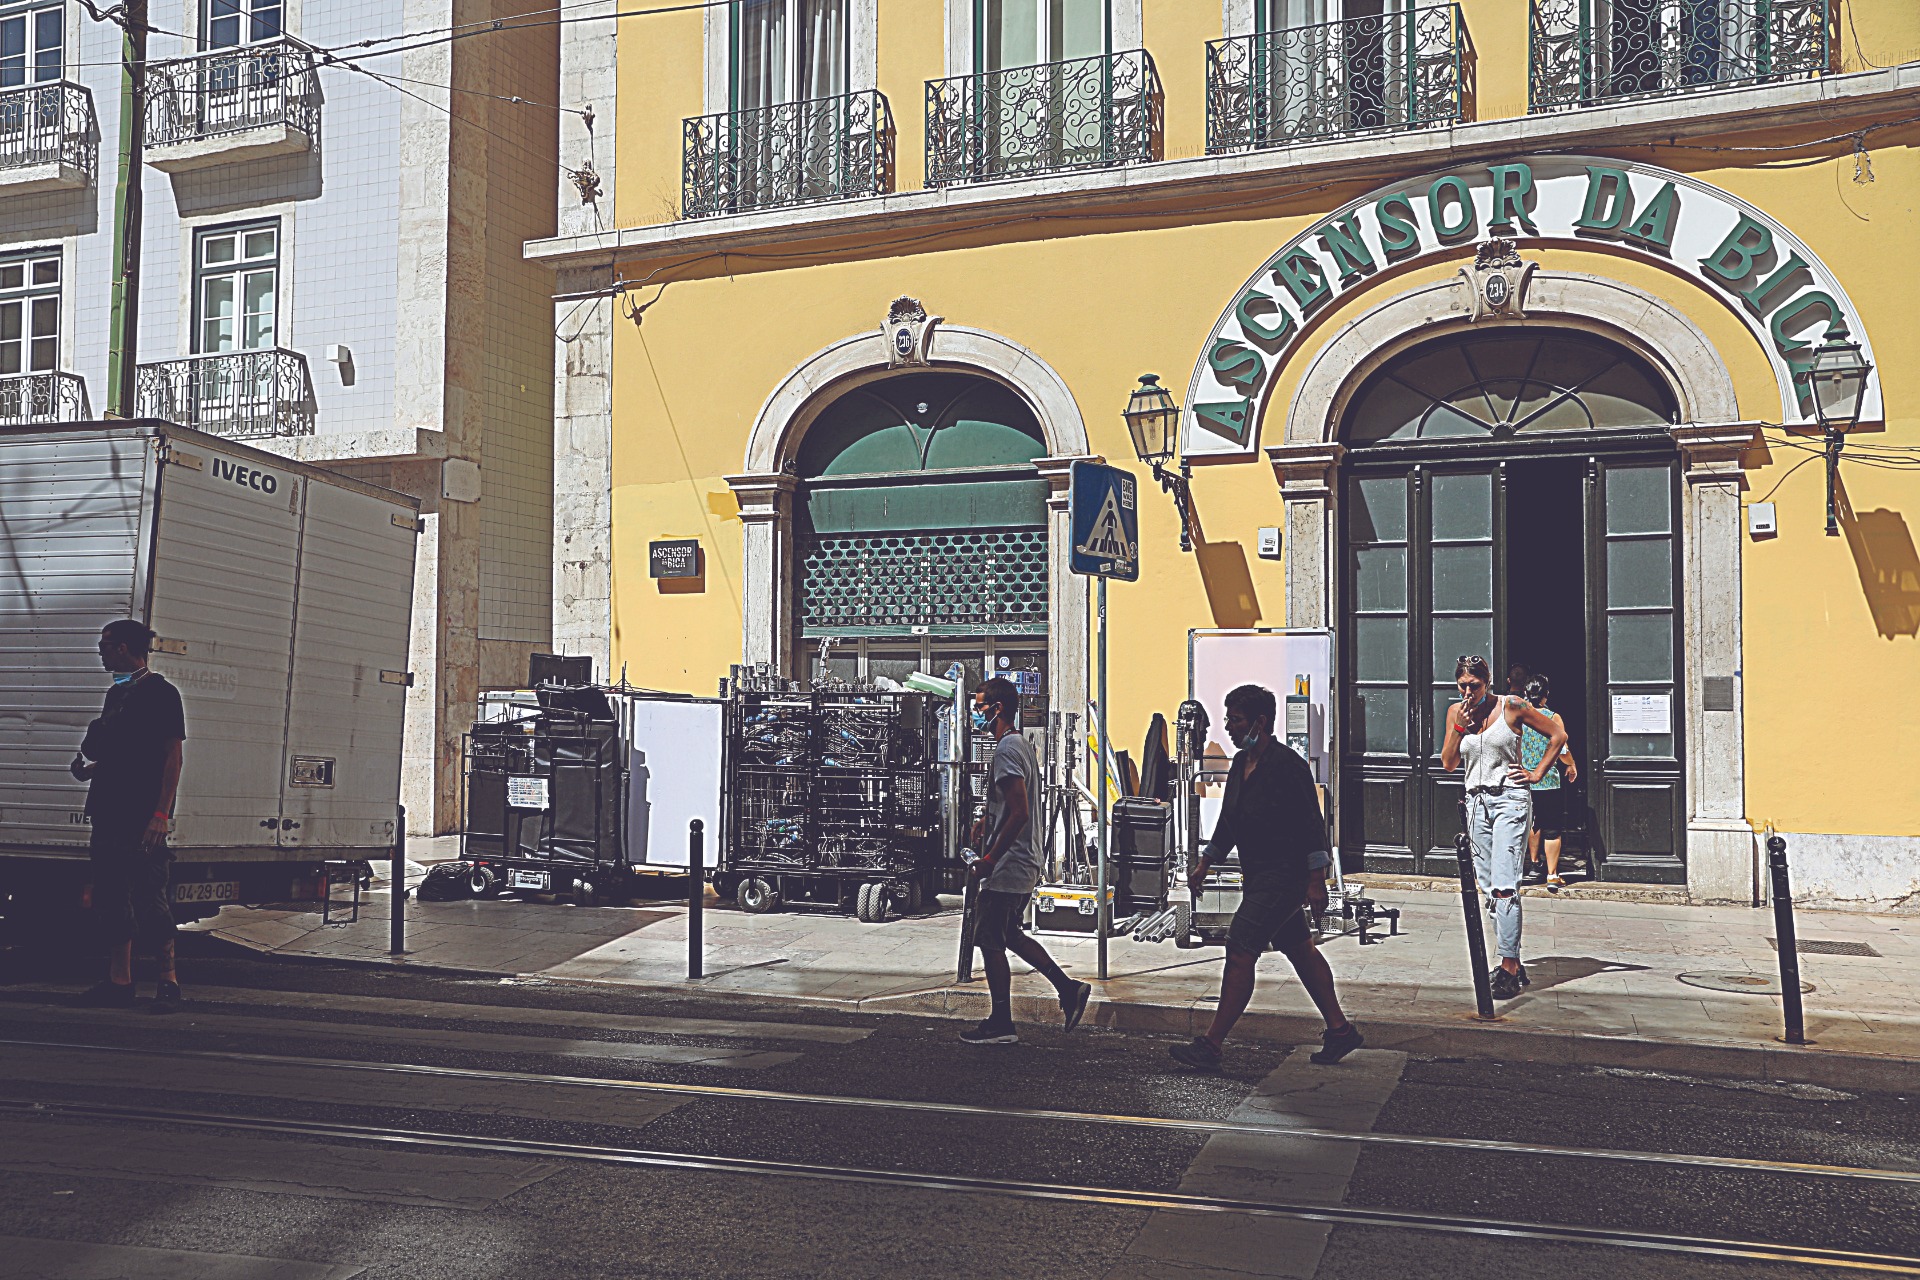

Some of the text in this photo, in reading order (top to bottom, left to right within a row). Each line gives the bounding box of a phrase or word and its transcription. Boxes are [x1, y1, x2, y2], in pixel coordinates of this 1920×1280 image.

[1489, 283, 1504, 298] 234
[1192, 163, 1538, 438] ASCENSOR
[1572, 165, 1672, 247] DA
[212, 458, 277, 494] IVECO
[652, 546, 692, 559] ASCENSOR
[667, 557, 686, 568] BICA
[69, 812, 91, 825] IVE
